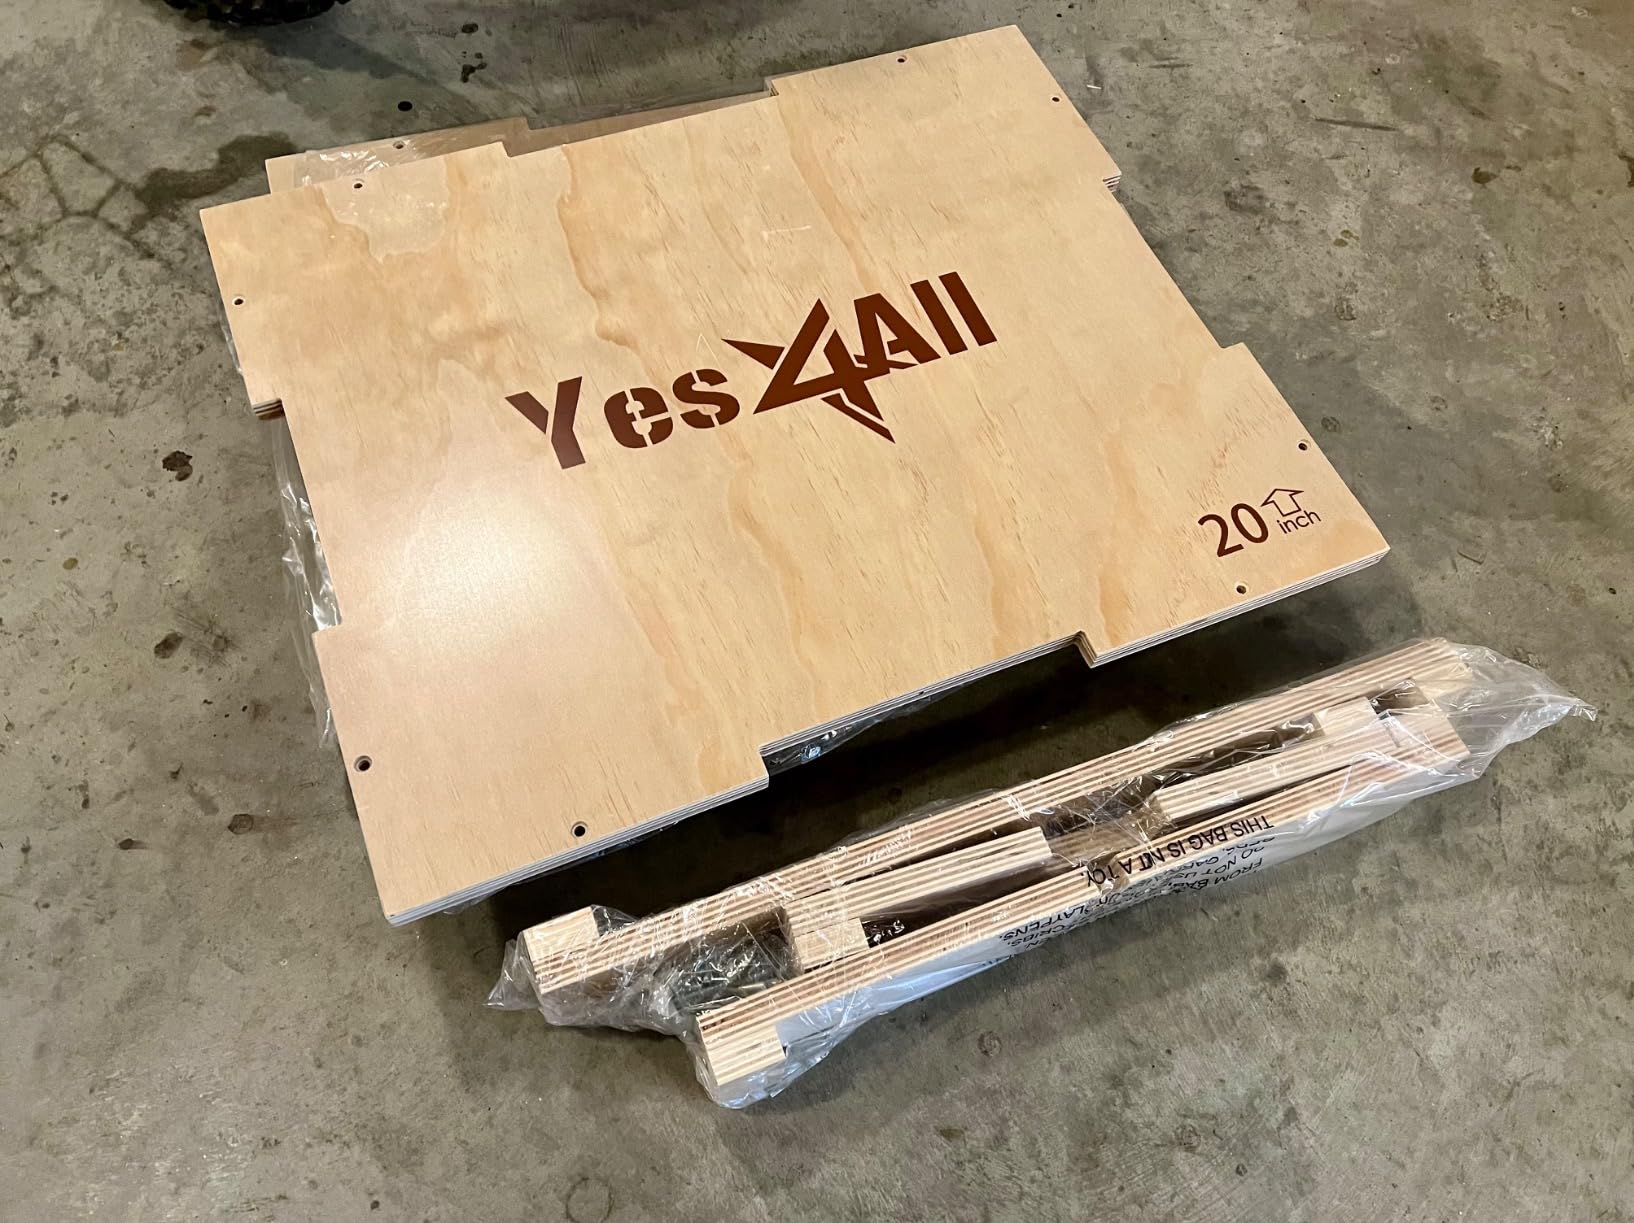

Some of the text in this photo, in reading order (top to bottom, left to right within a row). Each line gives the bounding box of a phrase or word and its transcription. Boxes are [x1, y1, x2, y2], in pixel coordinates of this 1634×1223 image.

[505, 271, 997, 469] Yes4All
[1198, 503, 1268, 557] 20
[1276, 510, 1321, 534] inch
[1188, 826, 1228, 850] BAG
[1231, 815, 1275, 837] THIS
[1167, 840, 1186, 858] IS
[1118, 858, 1132, 874] A
[1201, 855, 1237, 875] NOT
[1214, 858, 1262, 884] FROM
